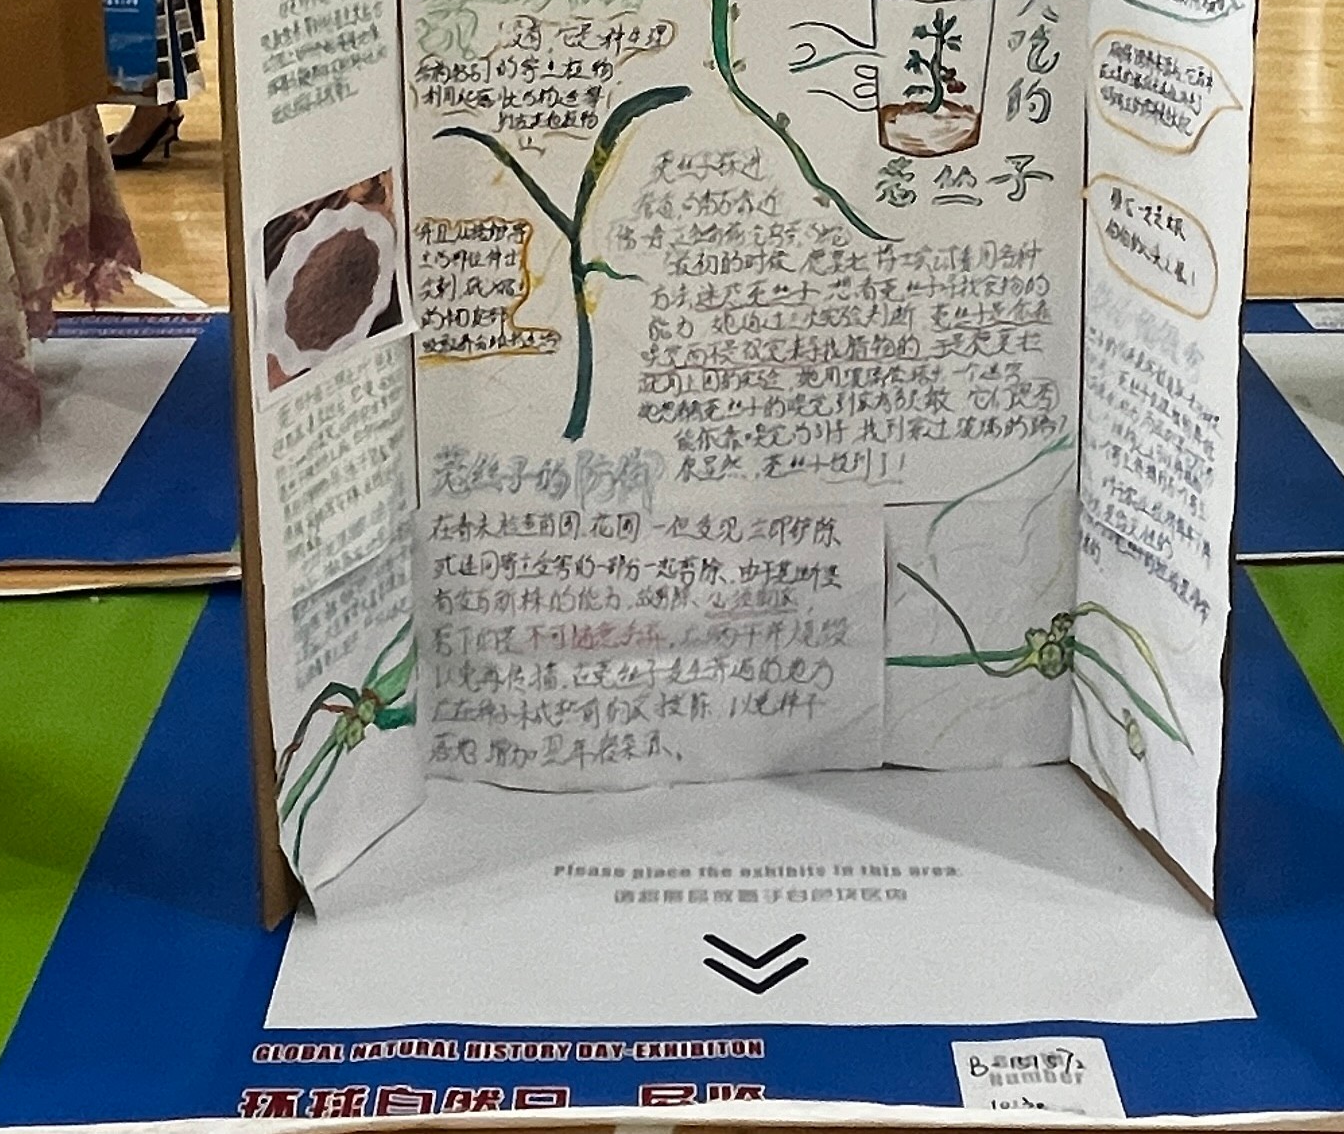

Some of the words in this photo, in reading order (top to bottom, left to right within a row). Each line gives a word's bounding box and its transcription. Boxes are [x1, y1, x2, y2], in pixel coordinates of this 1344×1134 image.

[698, 866, 734, 878] the
[833, 866, 854, 878] in
[253, 1044, 346, 1062] GLOBAL
[348, 1039, 460, 1061] NATURAL
[464, 1041, 573, 1061] HISTORY
